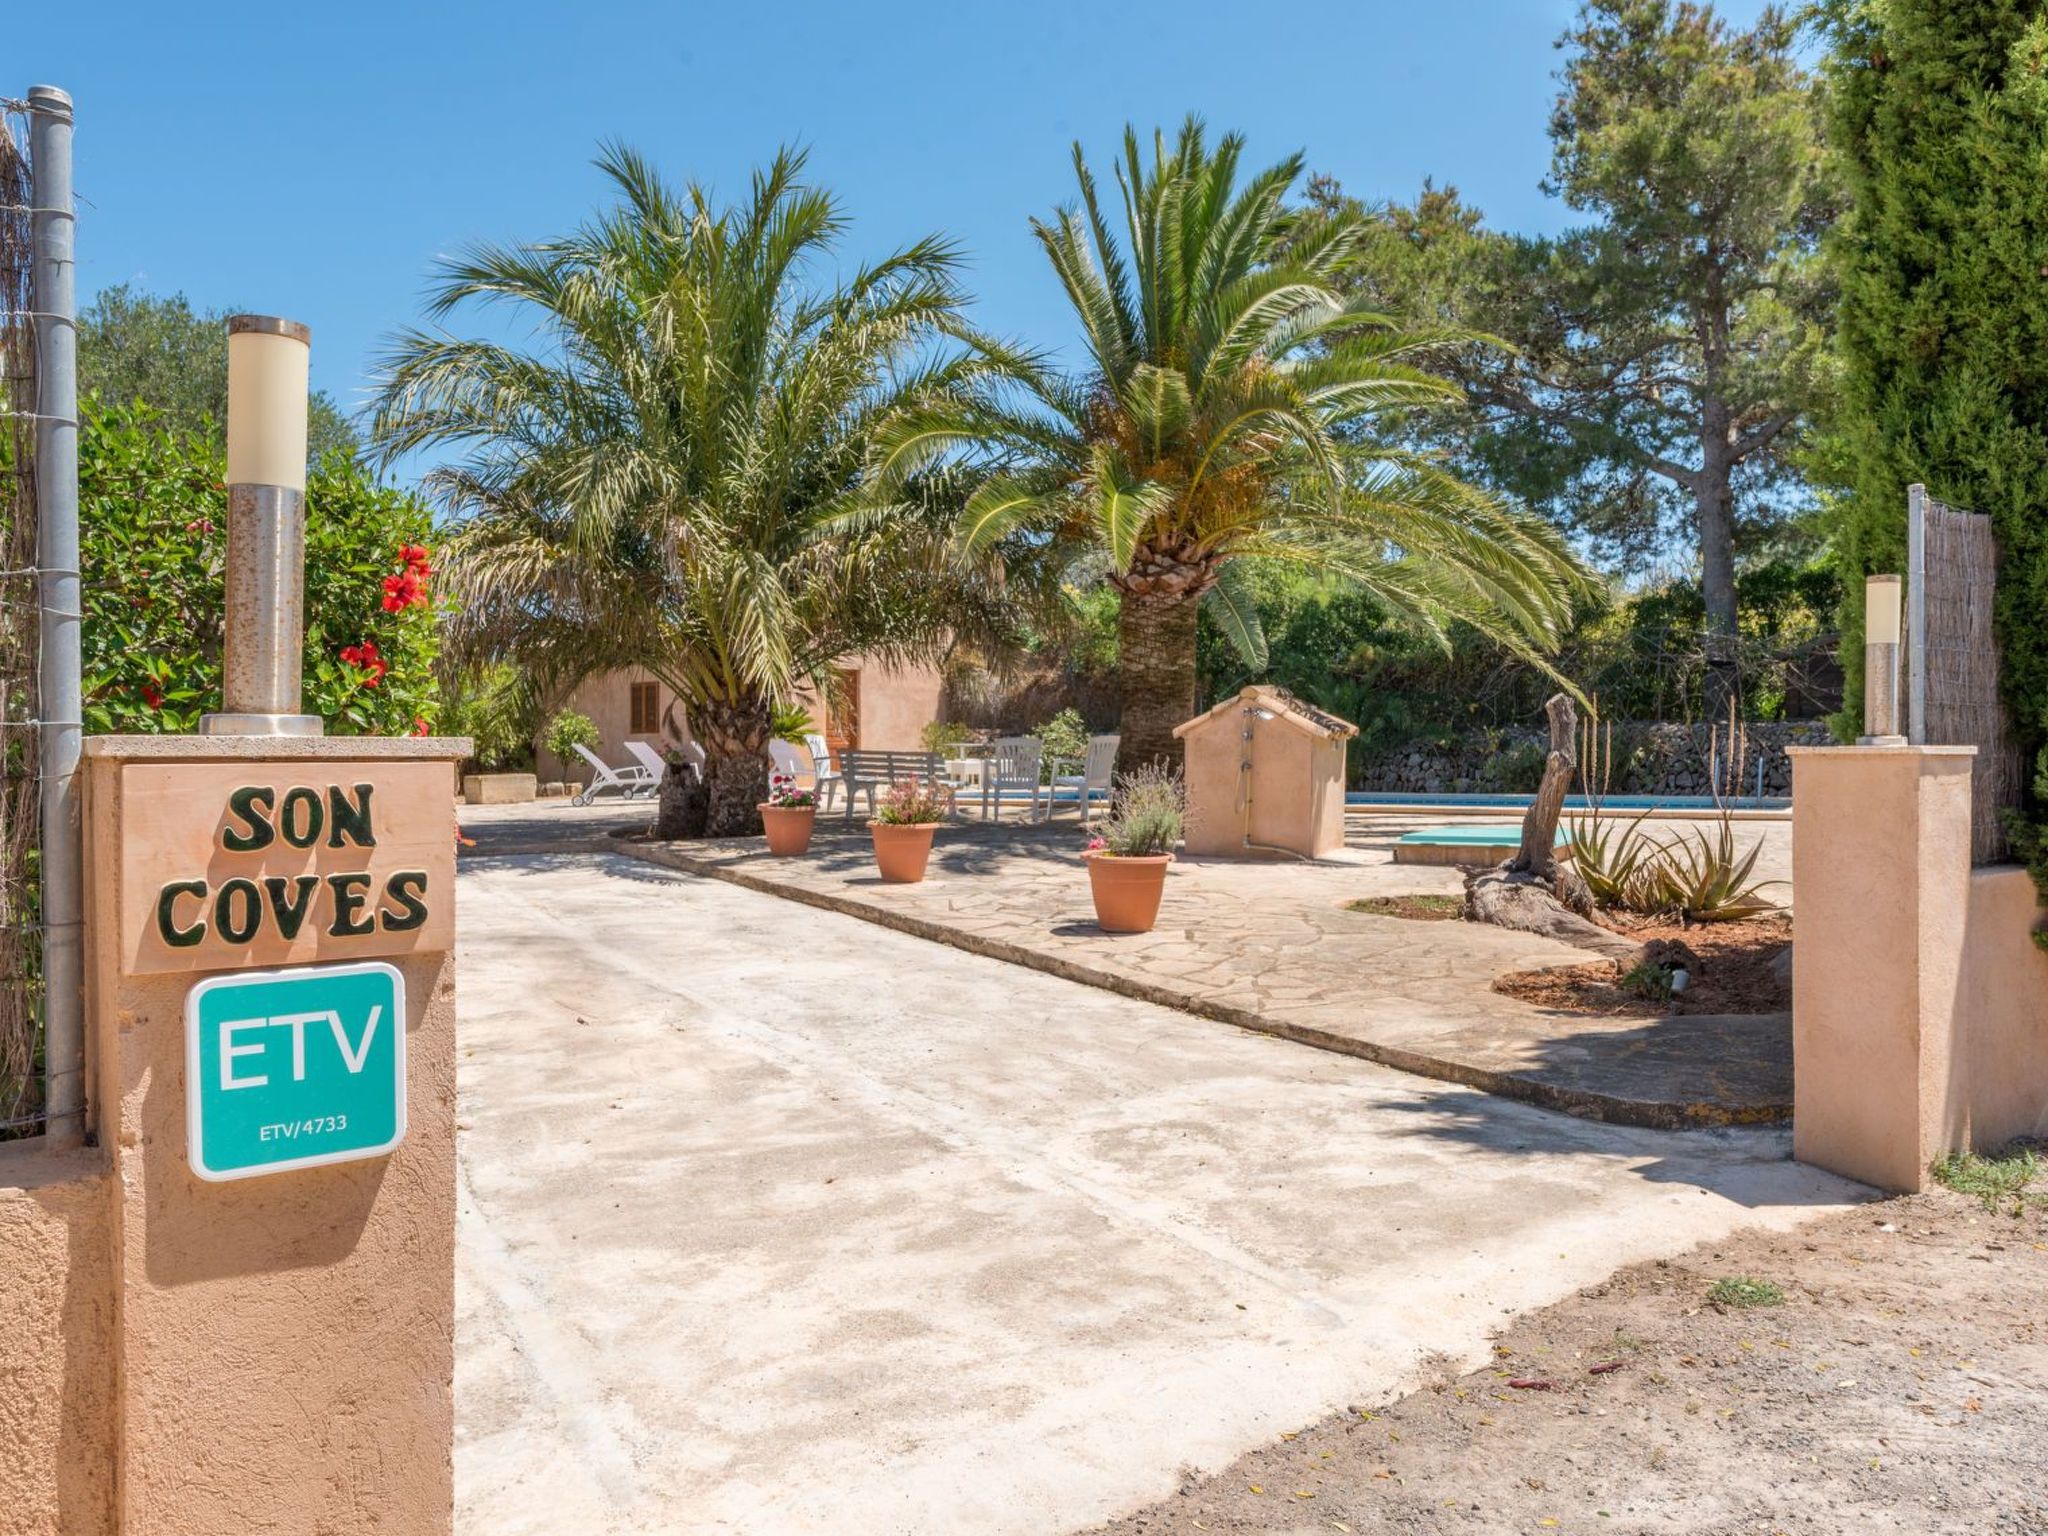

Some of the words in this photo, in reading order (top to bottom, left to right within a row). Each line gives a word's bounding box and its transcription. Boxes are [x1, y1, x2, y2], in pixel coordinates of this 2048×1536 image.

[222, 784, 377, 852] SON
[157, 871, 429, 947] COVES
[218, 1005, 382, 1091] ETV
[260, 1115, 347, 1142] ETV/4733
